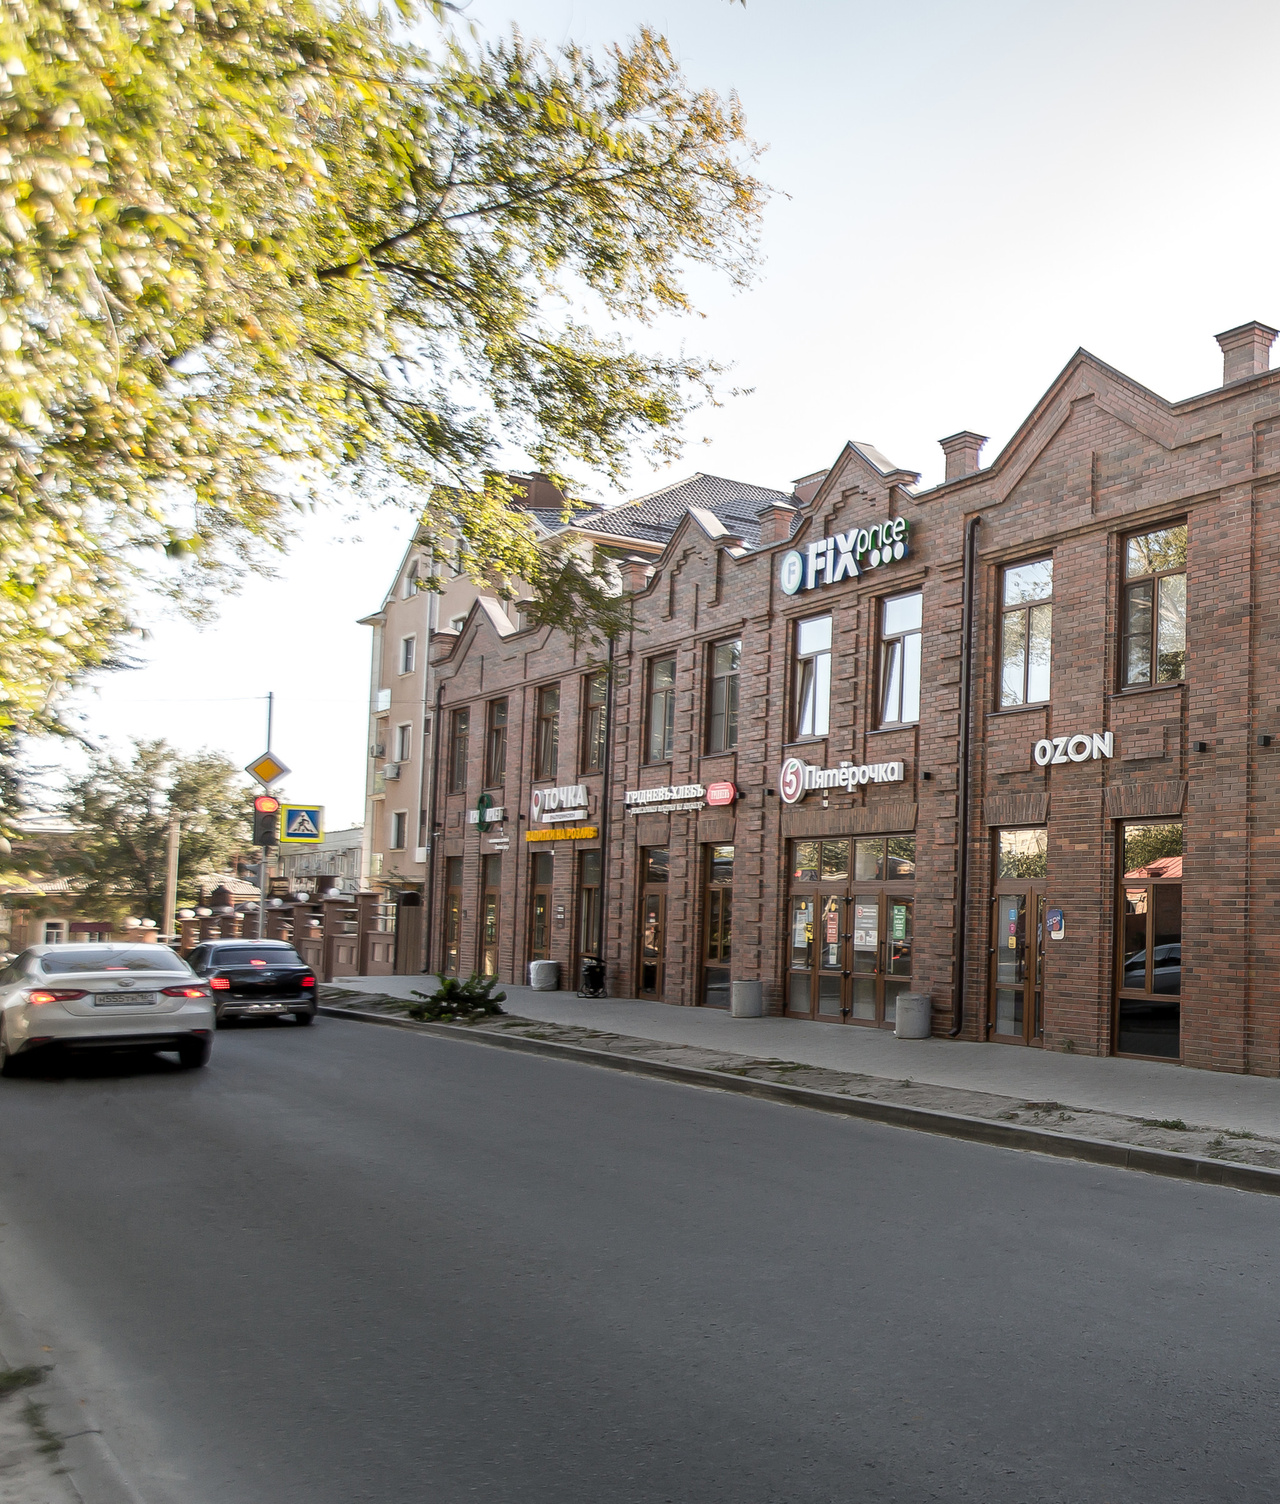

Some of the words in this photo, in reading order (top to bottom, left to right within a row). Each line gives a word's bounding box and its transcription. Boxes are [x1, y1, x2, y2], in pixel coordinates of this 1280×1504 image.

[1034, 731, 1114, 766] OZON
[805, 761, 904, 792] Пятёрочка
[543, 784, 588, 811] ТОЧКА
